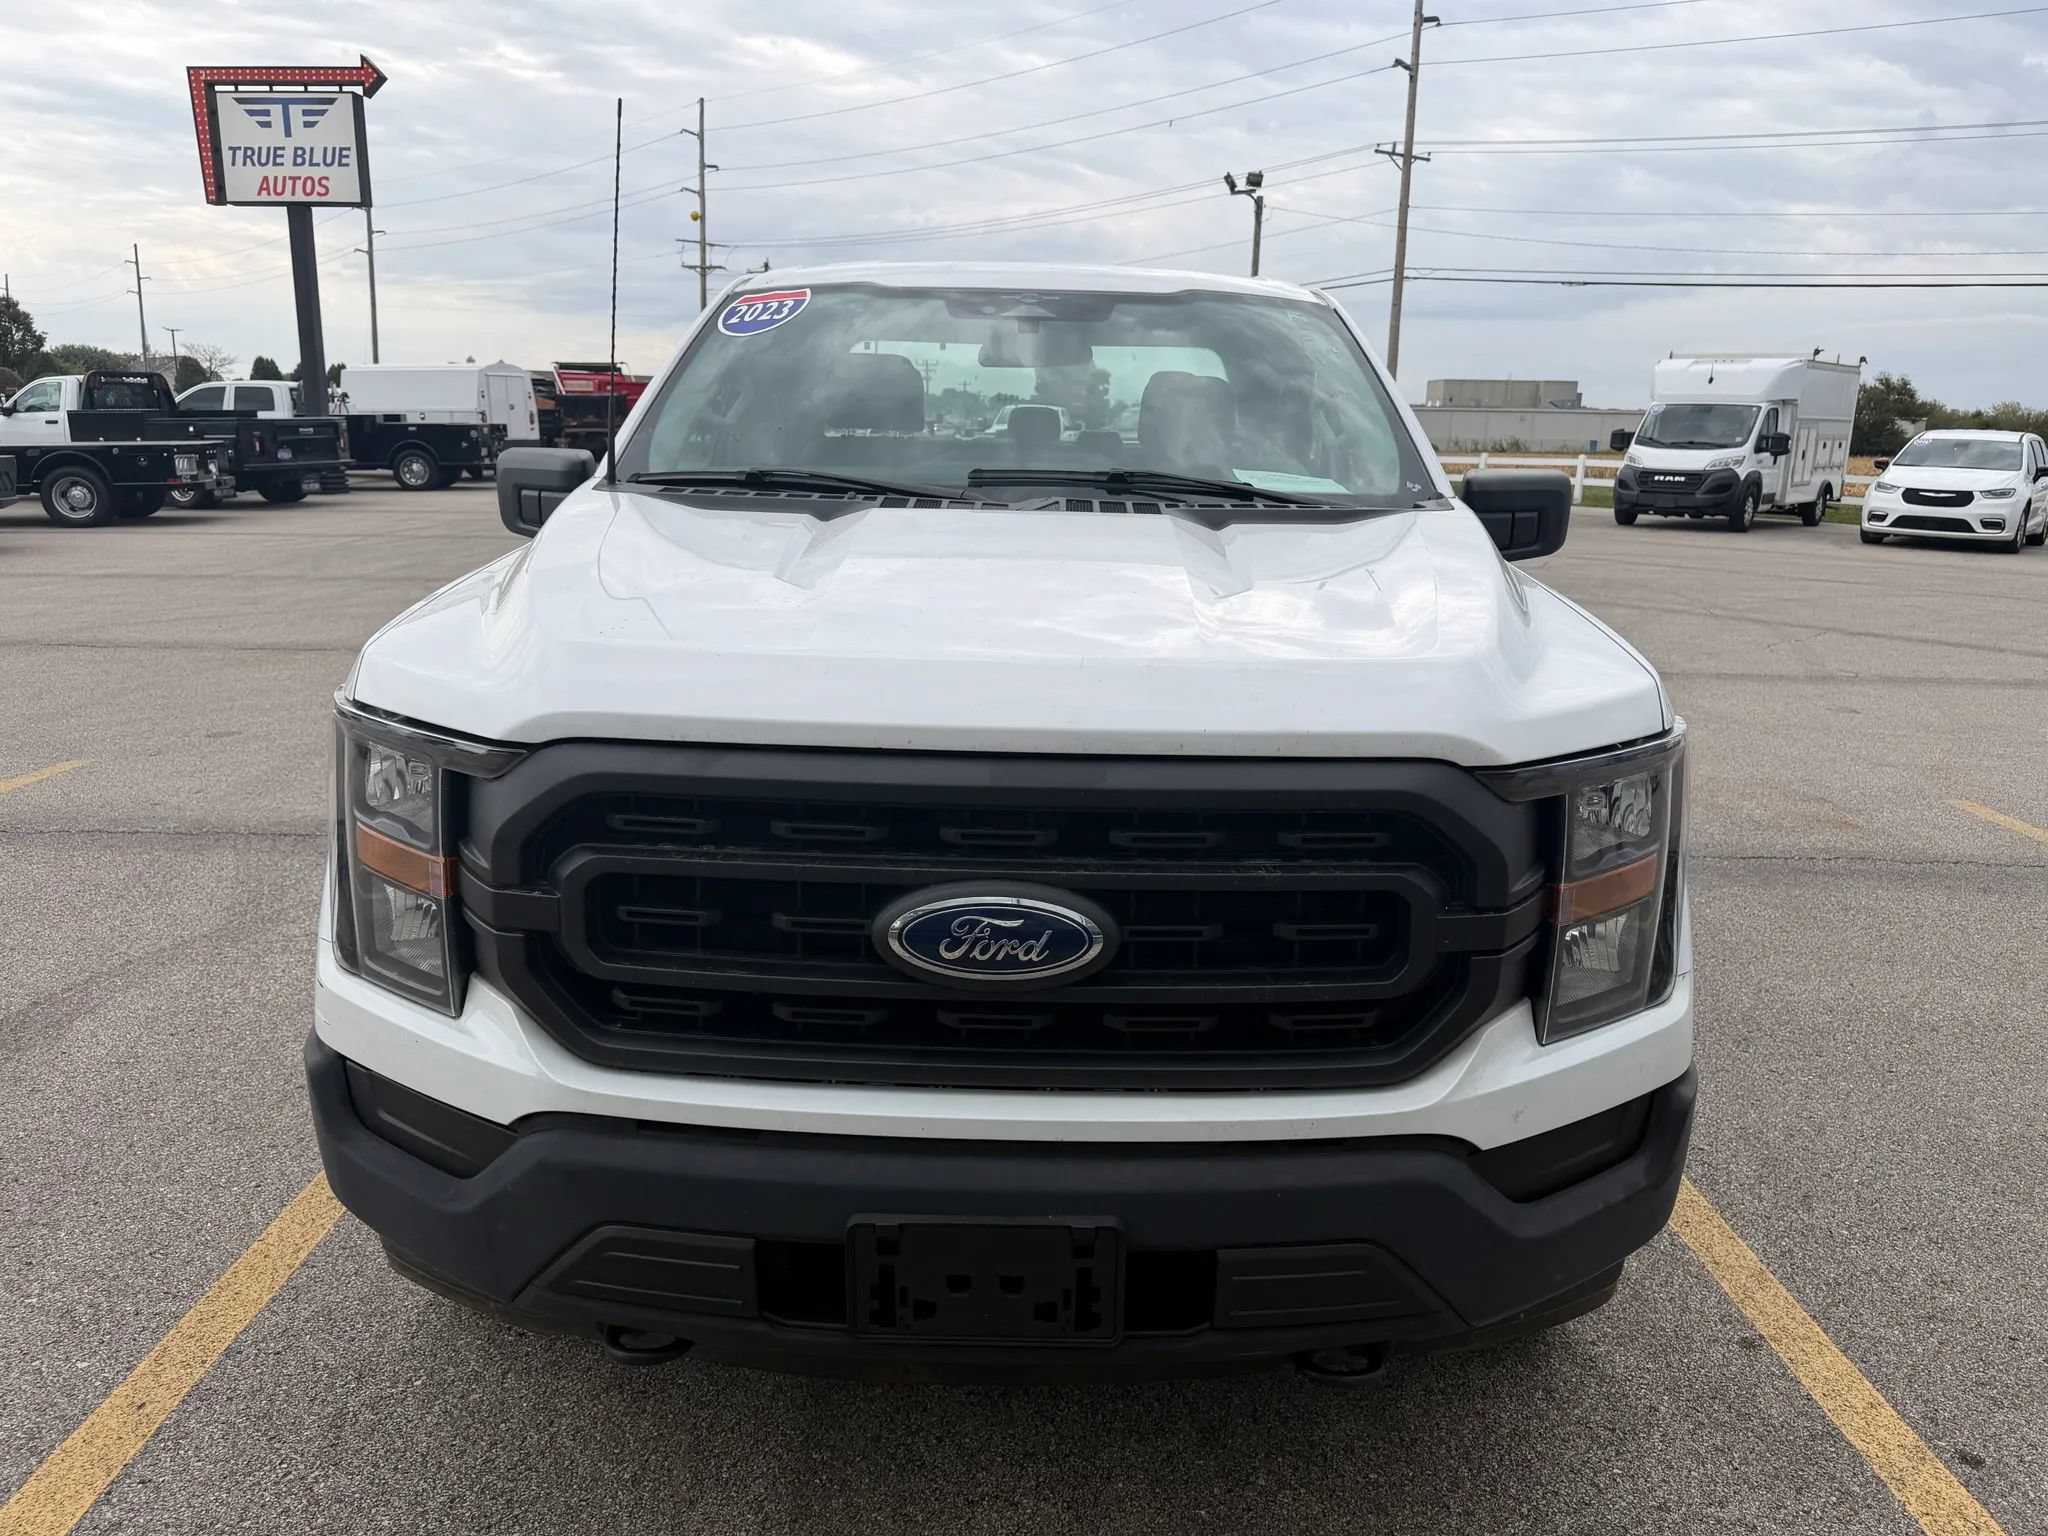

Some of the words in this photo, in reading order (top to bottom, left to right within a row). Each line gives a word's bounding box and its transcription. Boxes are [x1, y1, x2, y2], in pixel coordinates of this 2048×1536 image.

[228, 146, 285, 167] TRUE
[292, 146, 351, 168] BLUE
[256, 175, 330, 197] AUTOS
[725, 300, 795, 324] 2023
[938, 915, 1053, 961] Ford
